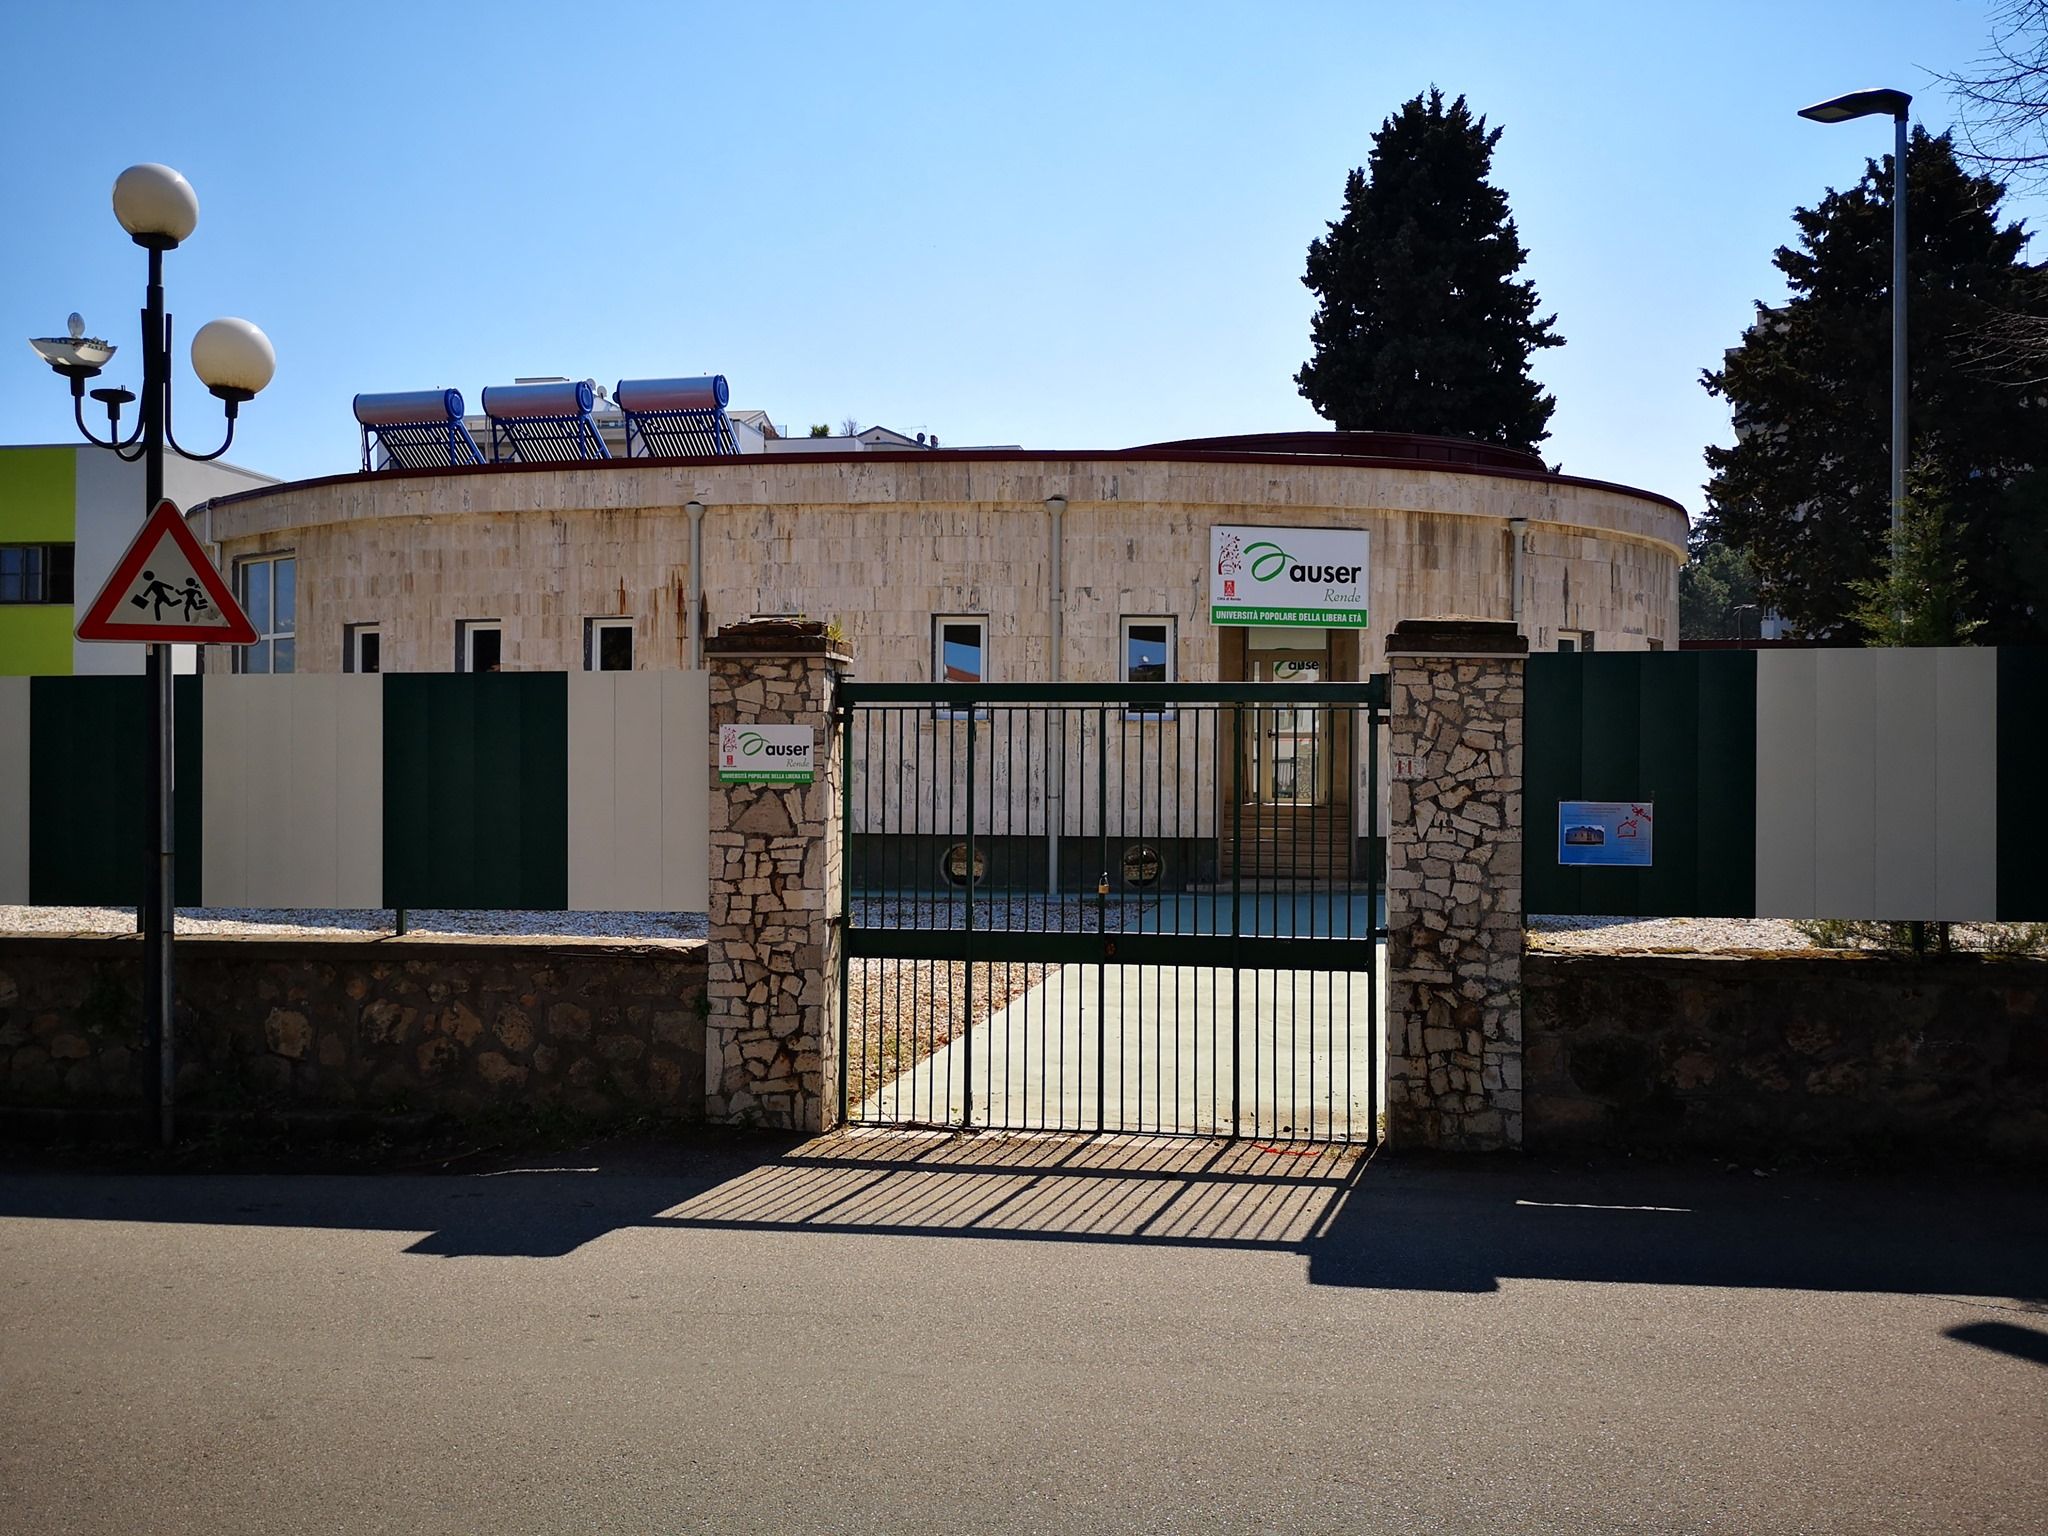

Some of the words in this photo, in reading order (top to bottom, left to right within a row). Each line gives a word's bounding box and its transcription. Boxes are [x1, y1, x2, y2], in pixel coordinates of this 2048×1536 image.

[1290, 564, 1361, 584] auser
[1324, 587, 1361, 602] Rende
[1216, 610, 1258, 620] UNIVERSITÀ
[1260, 611, 1297, 621] POPOLARE
[1300, 613, 1320, 622] DELLA
[1322, 613, 1347, 622] LIBERA
[1349, 613, 1362, 623] ETÀ
[1288, 660, 1319, 670] ause
[765, 744, 809, 756] auser
[786, 757, 810, 768] Rende
